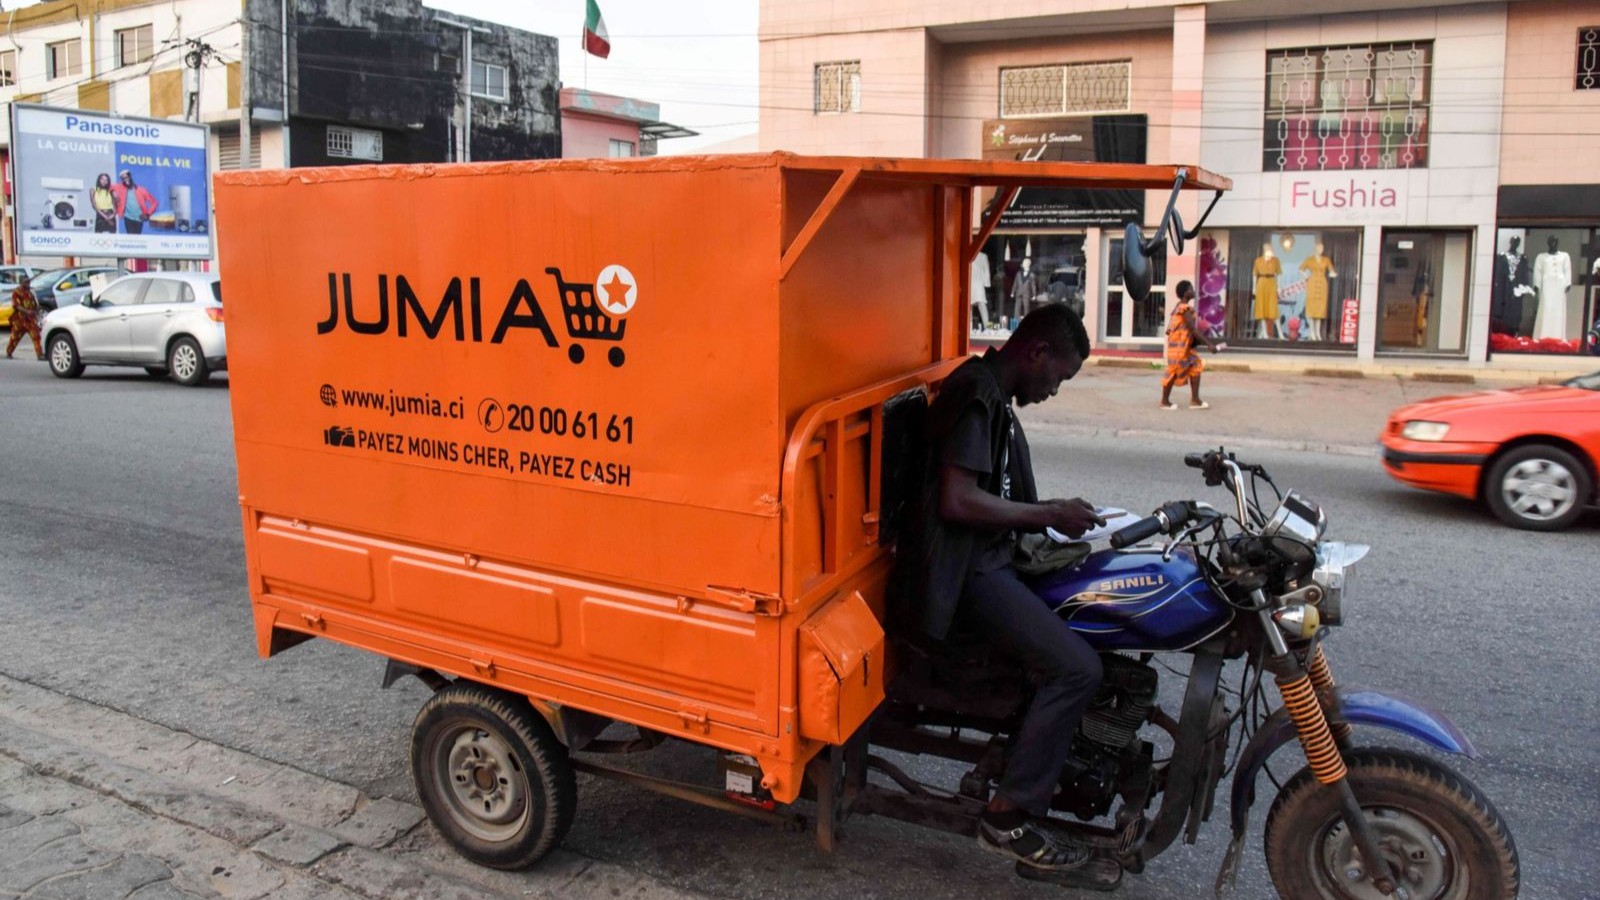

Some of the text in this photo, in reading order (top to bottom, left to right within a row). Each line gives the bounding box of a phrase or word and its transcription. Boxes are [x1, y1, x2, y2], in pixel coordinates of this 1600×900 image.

[65, 116, 160, 138] Panasonic
[37, 139, 110, 154] LA QUALITÉ
[120, 154, 191, 169] POUR LA VIE
[1292, 179, 1397, 208] Fushia
[30, 236, 71, 245] SONOCO
[317, 272, 560, 348] JUMIA
[342, 389, 464, 420] www.jumia.ci
[507, 403, 633, 444] 20 00 61 61
[358, 430, 631, 487] PAYEZ MOINS CHER, PAYEZ CASH
[1100, 574, 1164, 591] SANILI
